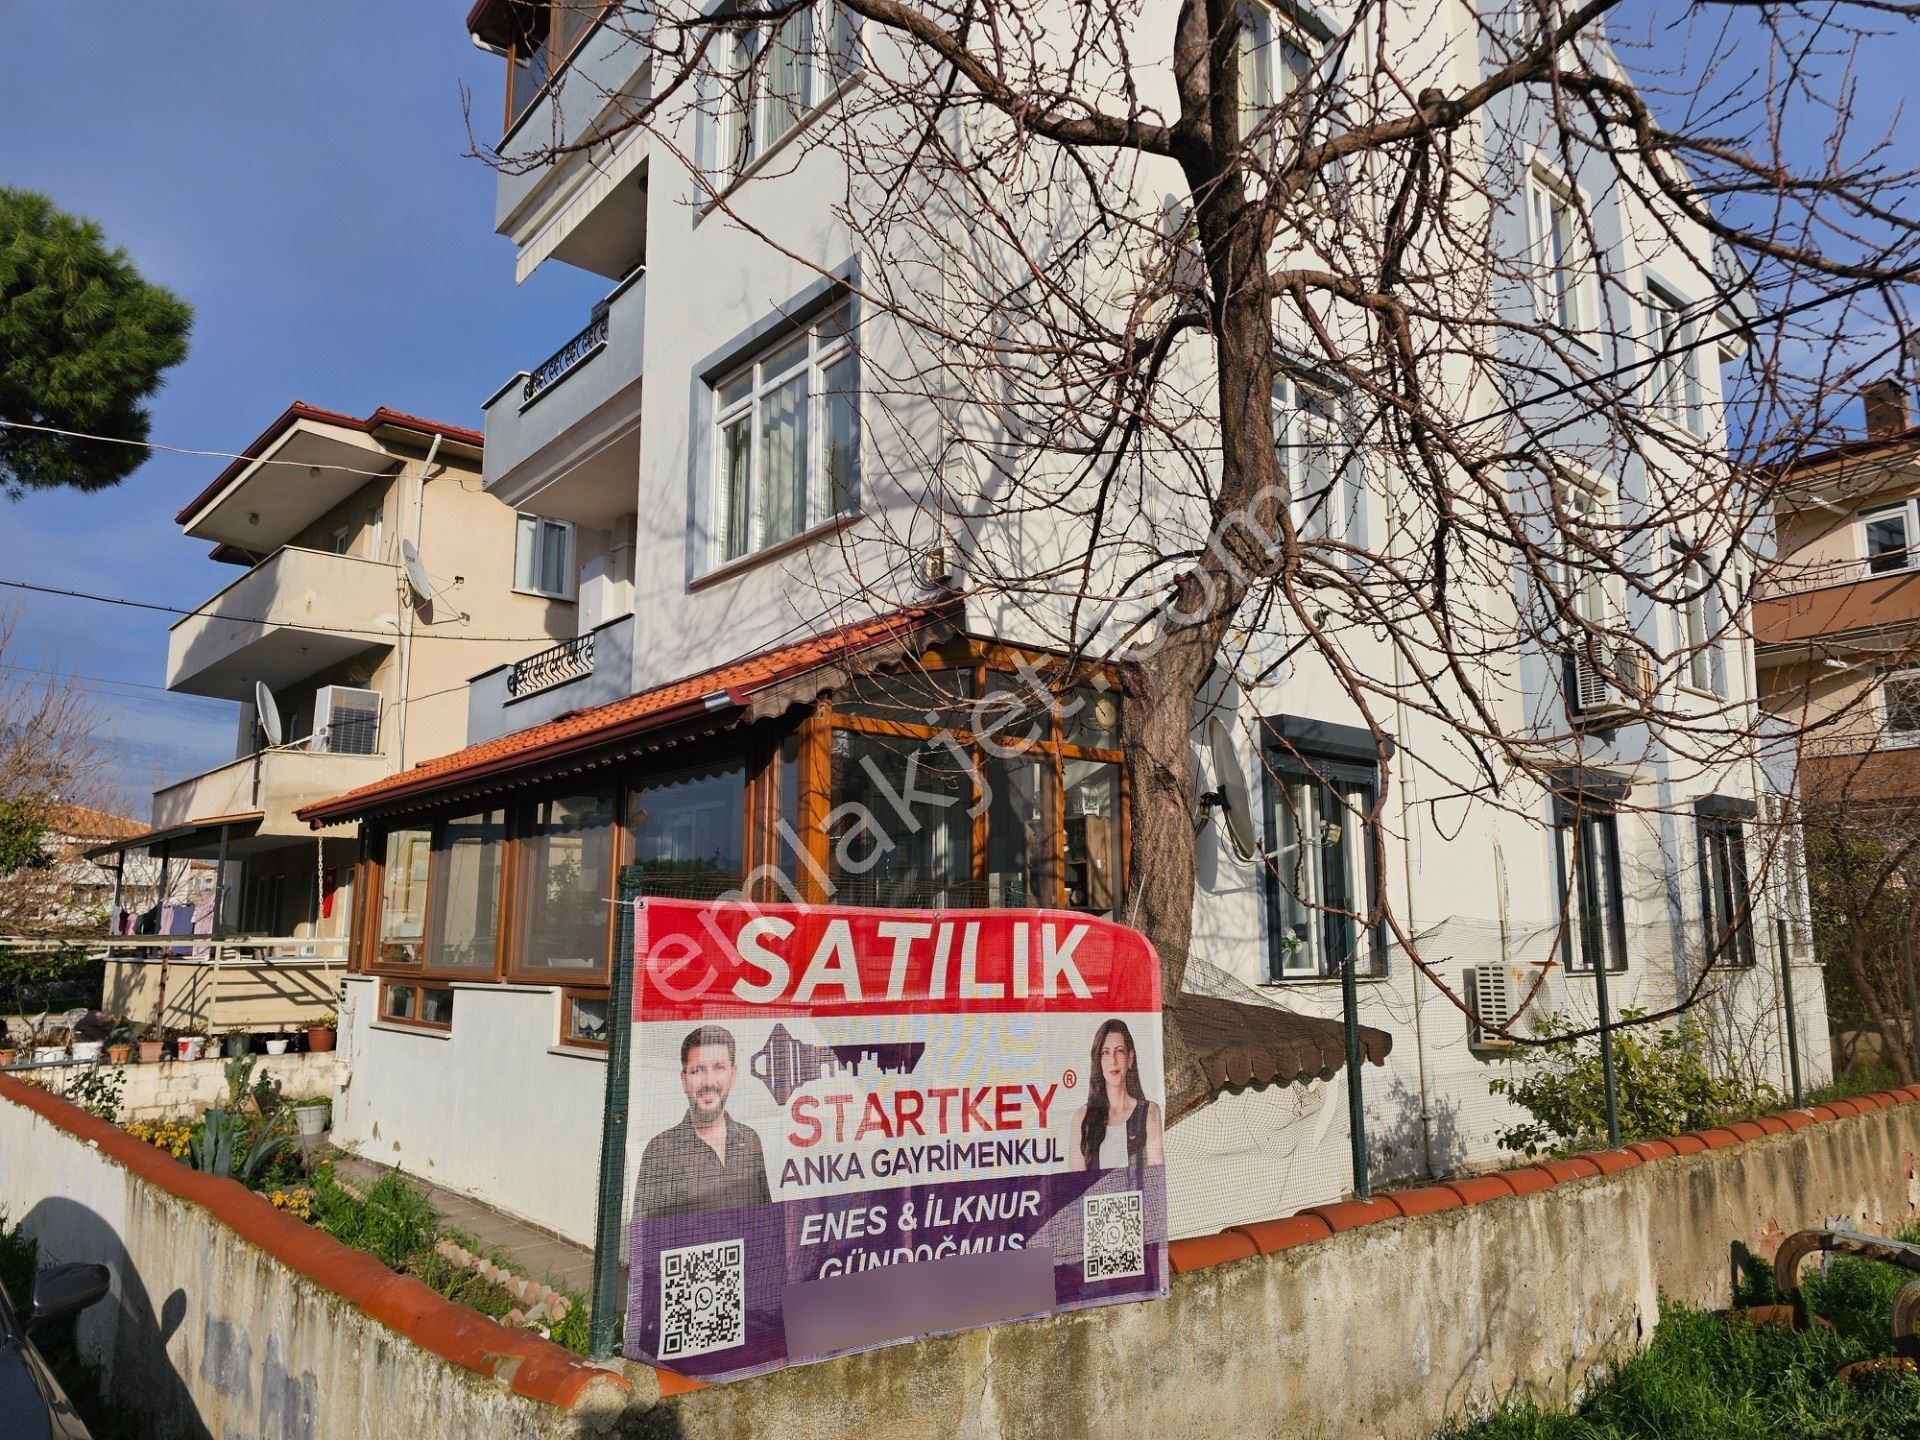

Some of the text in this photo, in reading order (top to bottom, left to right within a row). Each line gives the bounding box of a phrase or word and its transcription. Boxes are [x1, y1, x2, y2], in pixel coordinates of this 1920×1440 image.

[732, 916, 1093, 1004] SATILIK
[788, 1083, 1058, 1147] STARTKEY
[779, 1137, 1064, 1188] ANKA GAYRİMENKUL
[800, 1190, 1040, 1246] ENES & İLKNUR
